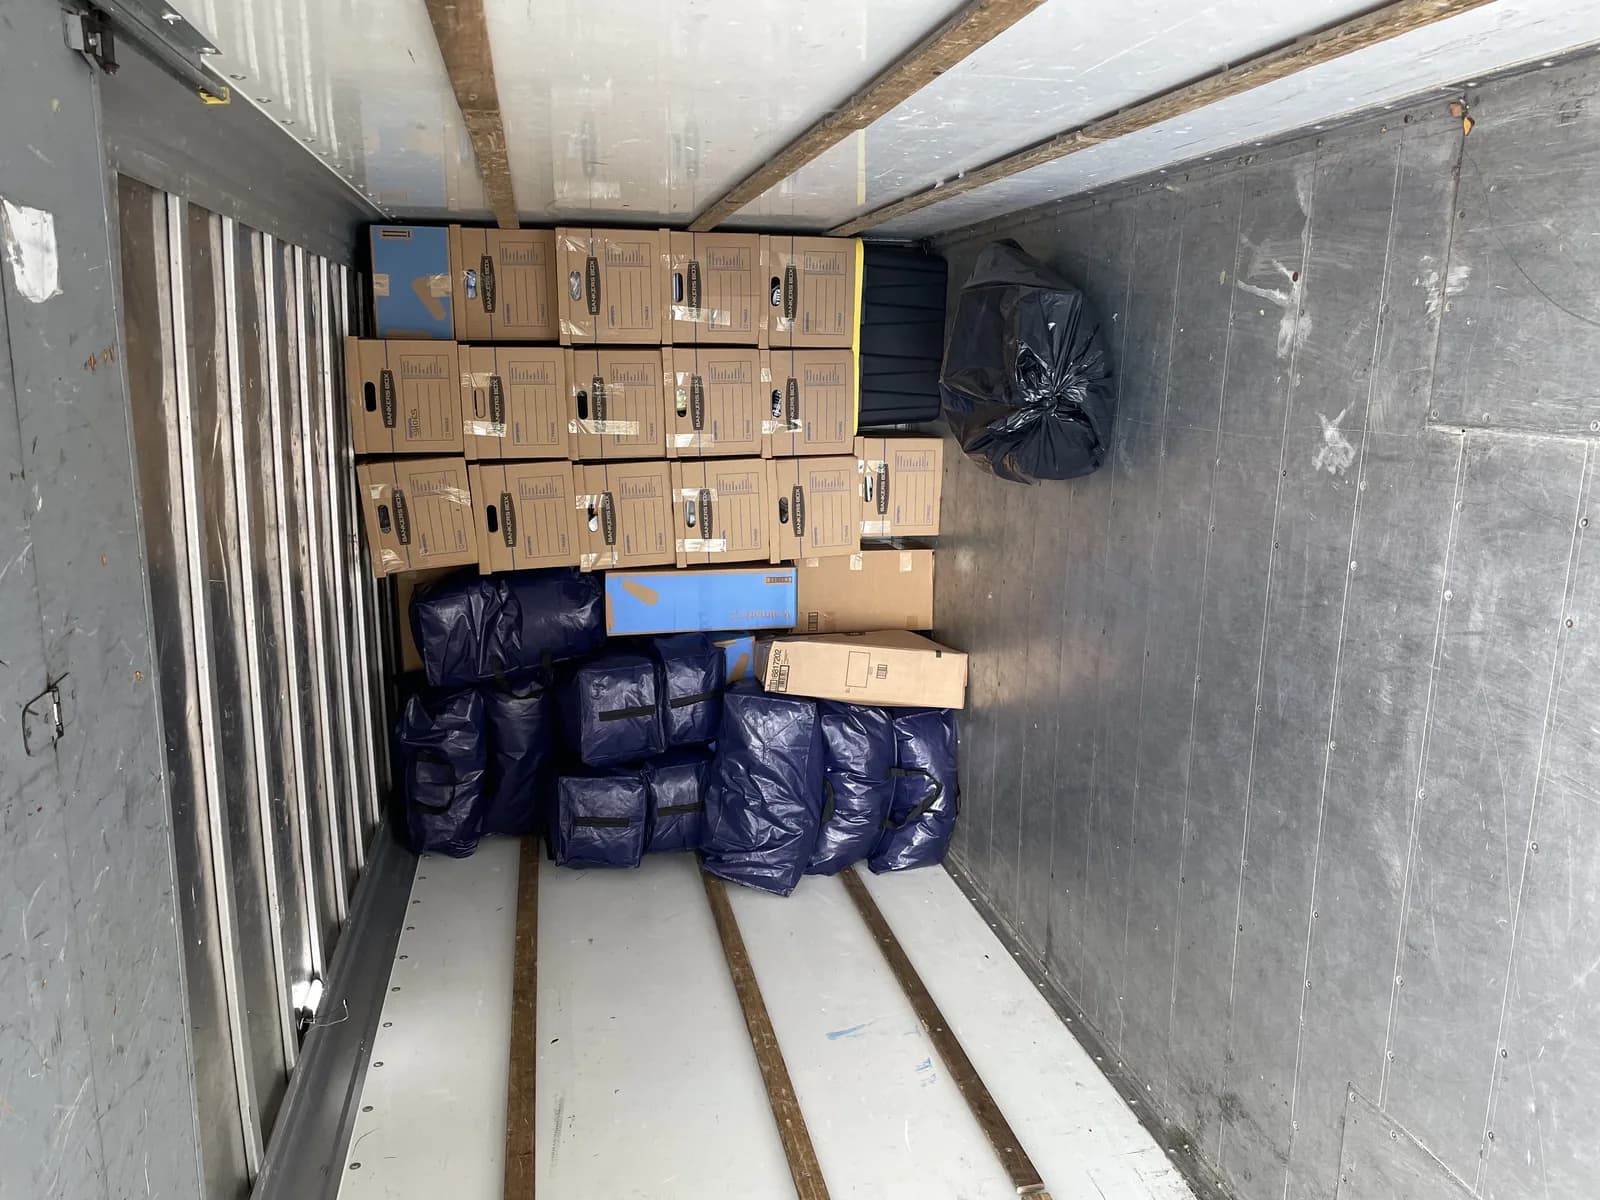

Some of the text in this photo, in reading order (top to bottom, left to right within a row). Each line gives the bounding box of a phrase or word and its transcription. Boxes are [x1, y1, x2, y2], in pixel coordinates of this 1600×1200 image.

[385, 391, 393, 425] BANKERS
[398, 509, 408, 542] BANKERS
[505, 511, 513, 544] BANKERS
